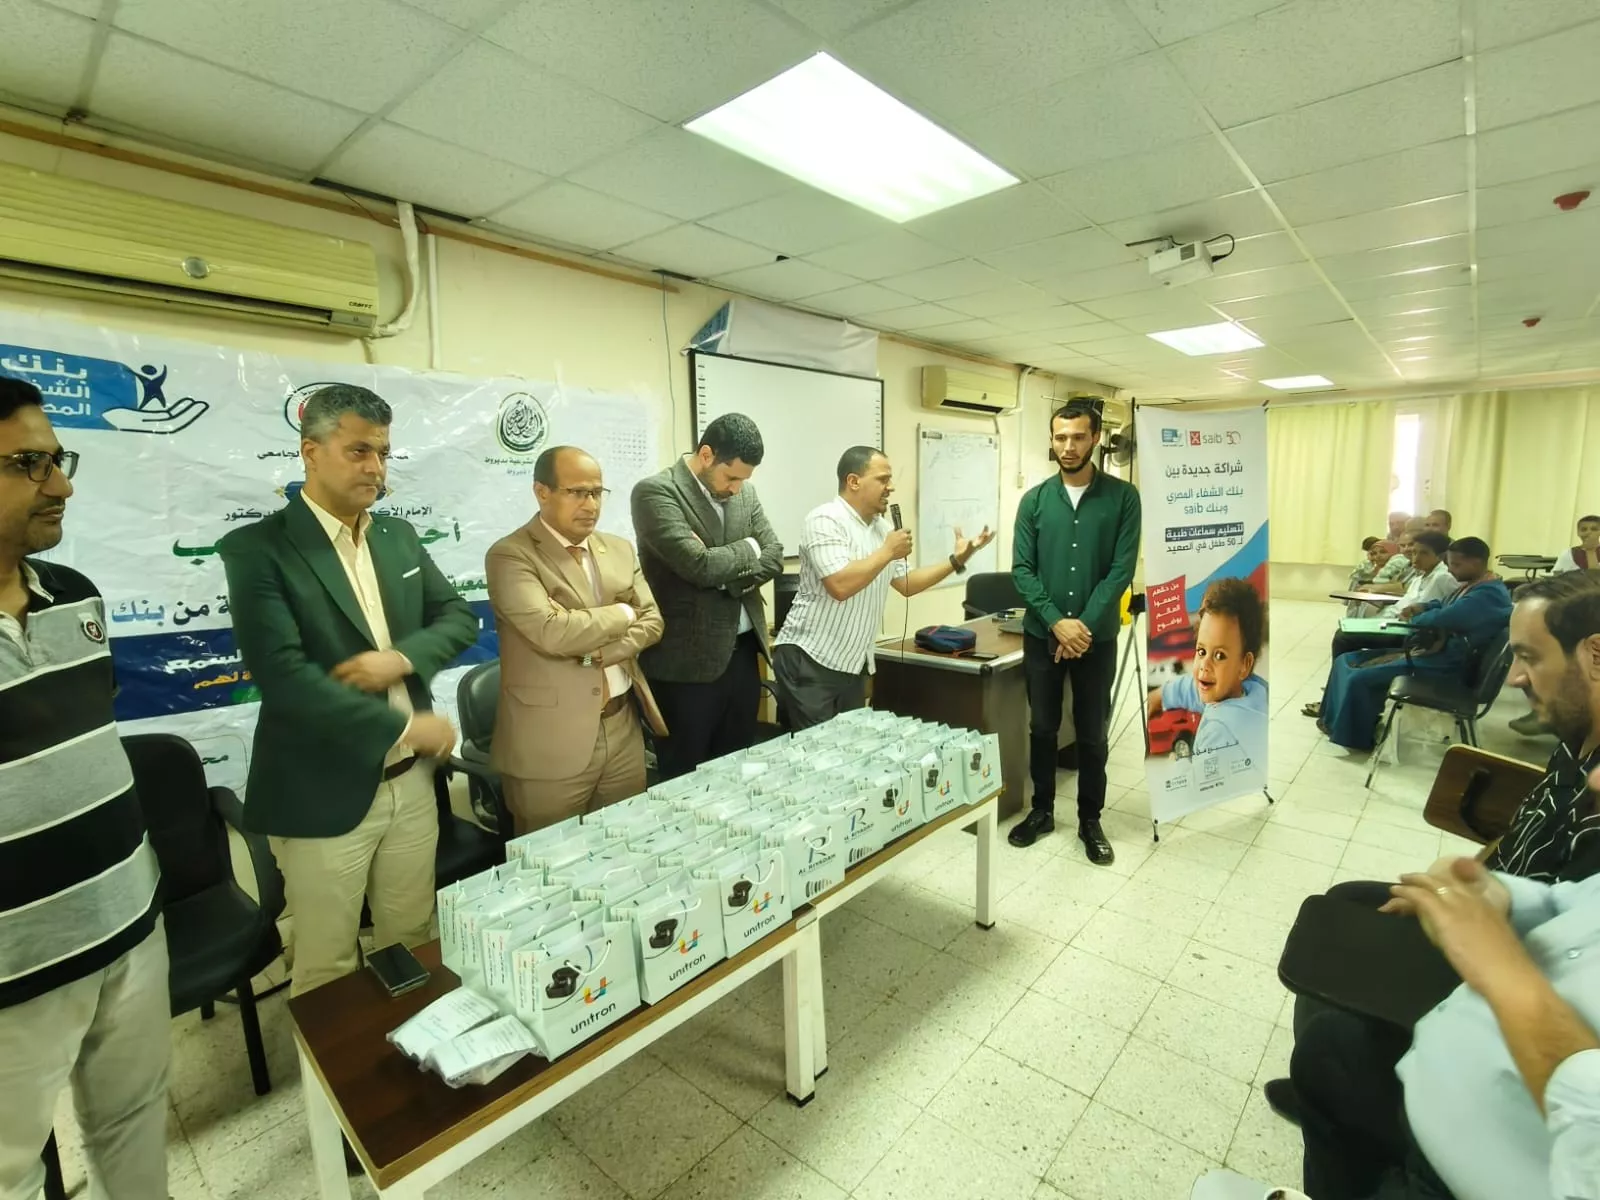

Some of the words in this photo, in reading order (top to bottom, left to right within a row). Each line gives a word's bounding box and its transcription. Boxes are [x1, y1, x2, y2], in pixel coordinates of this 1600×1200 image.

[1, 354, 88, 384] بنك
[40, 402, 91, 416] المص
[1203, 432, 1223, 444] saib
[257, 450, 300, 460] لجامعي
[1165, 465, 1180, 478] بين
[1182, 464, 1211, 478] جديدة
[1214, 459, 1243, 476] شراكة
[1166, 487, 1193, 504] المصري
[1196, 485, 1224, 498] الشفاء
[1226, 485, 1243, 498] بنك
[374, 504, 403, 516] الأك
[1184, 502, 1203, 514] saib
[1206, 503, 1228, 515] وبنك
[1166, 529, 1187, 541] طبية
[1188, 526, 1216, 537] سماعات
[1217, 523, 1243, 537] لتسليم
[1196, 542, 1207, 553] في
[1208, 540, 1225, 550] طفل
[1226, 537, 1236, 546] 50
[1166, 542, 1193, 555] الصعيد
[111, 600, 165, 627] بنك
[173, 601, 210, 625] من
[891, 818, 912, 832] unitron
[743, 913, 776, 939] unitron
[668, 952, 707, 982] unitron
[570, 1001, 617, 1035] unitron
